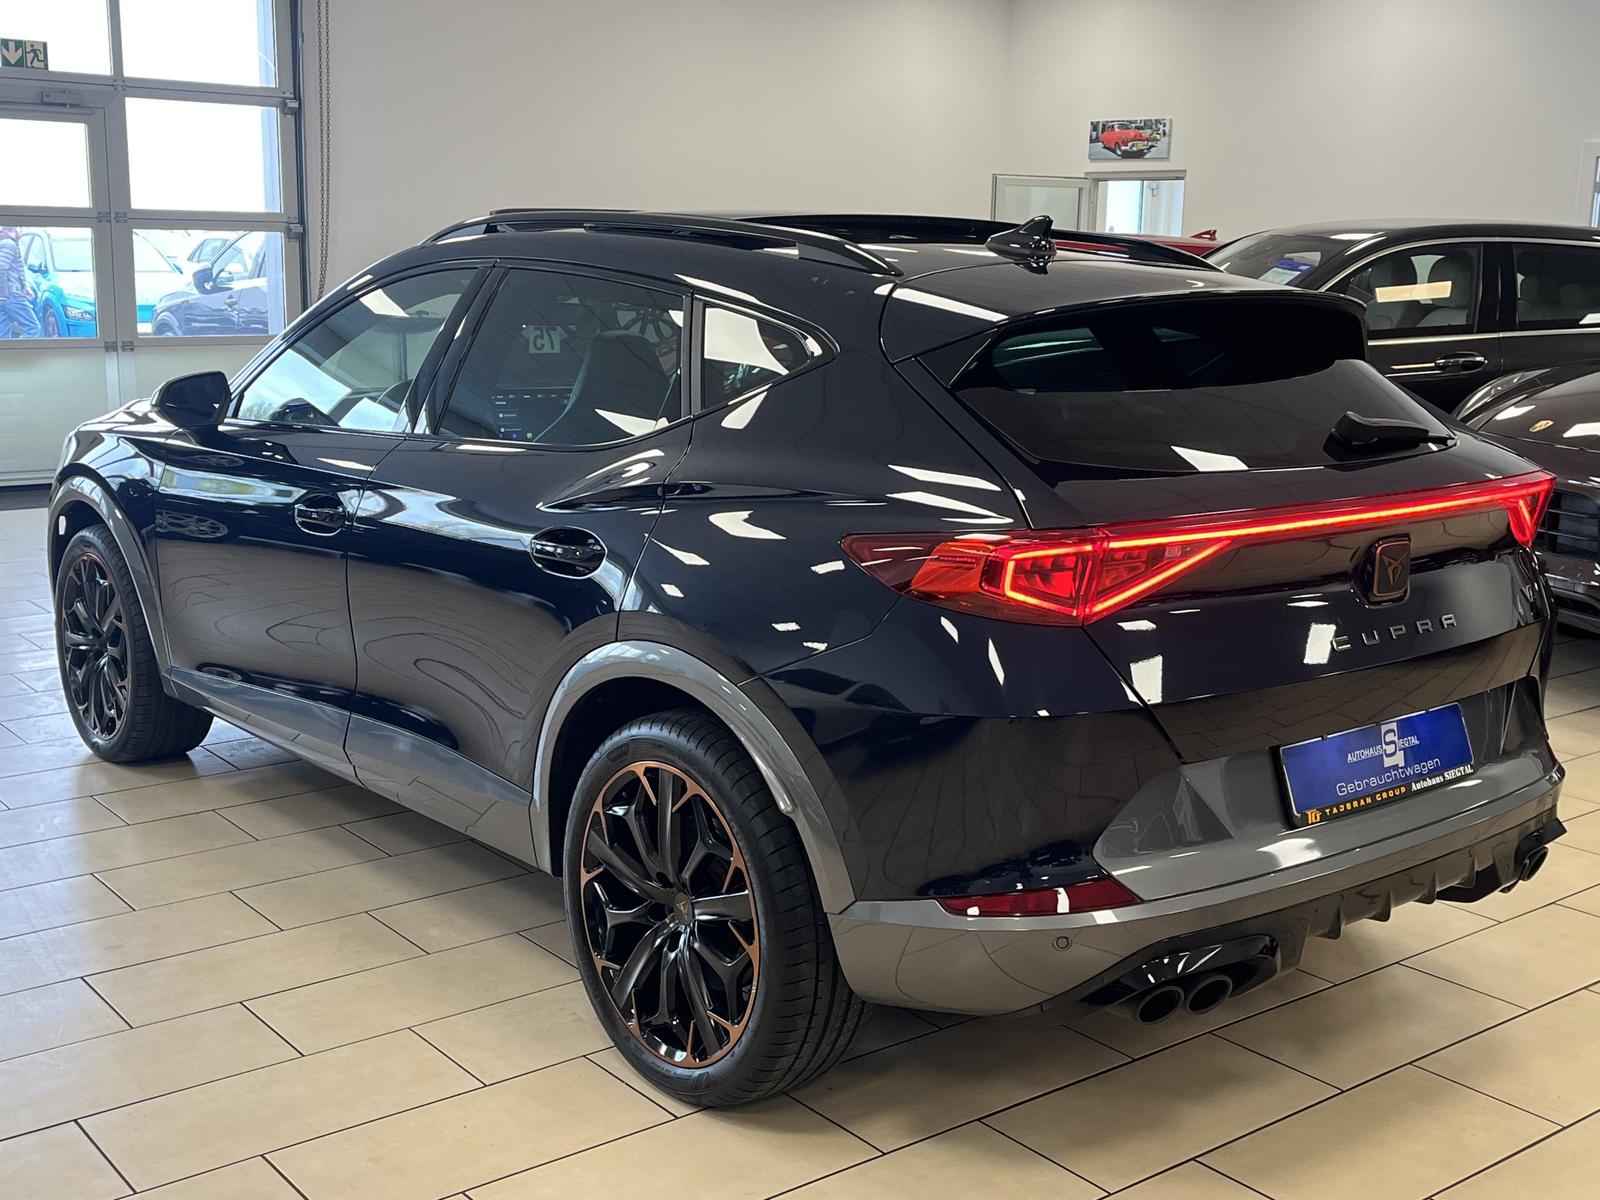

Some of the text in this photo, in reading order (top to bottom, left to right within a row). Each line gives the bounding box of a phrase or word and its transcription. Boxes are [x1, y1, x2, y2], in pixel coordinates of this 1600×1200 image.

[1332, 613, 1457, 651] CUPRA
[1347, 744, 1383, 763] AUTOHAUS
[1325, 797, 1372, 816] TAJERAN
[1376, 785, 1407, 801] GROUP
[1411, 775, 1444, 792] Autohaus
[1444, 764, 1474, 781] SIEGTAL
[1336, 757, 1441, 796] Gebrauchtwagen
